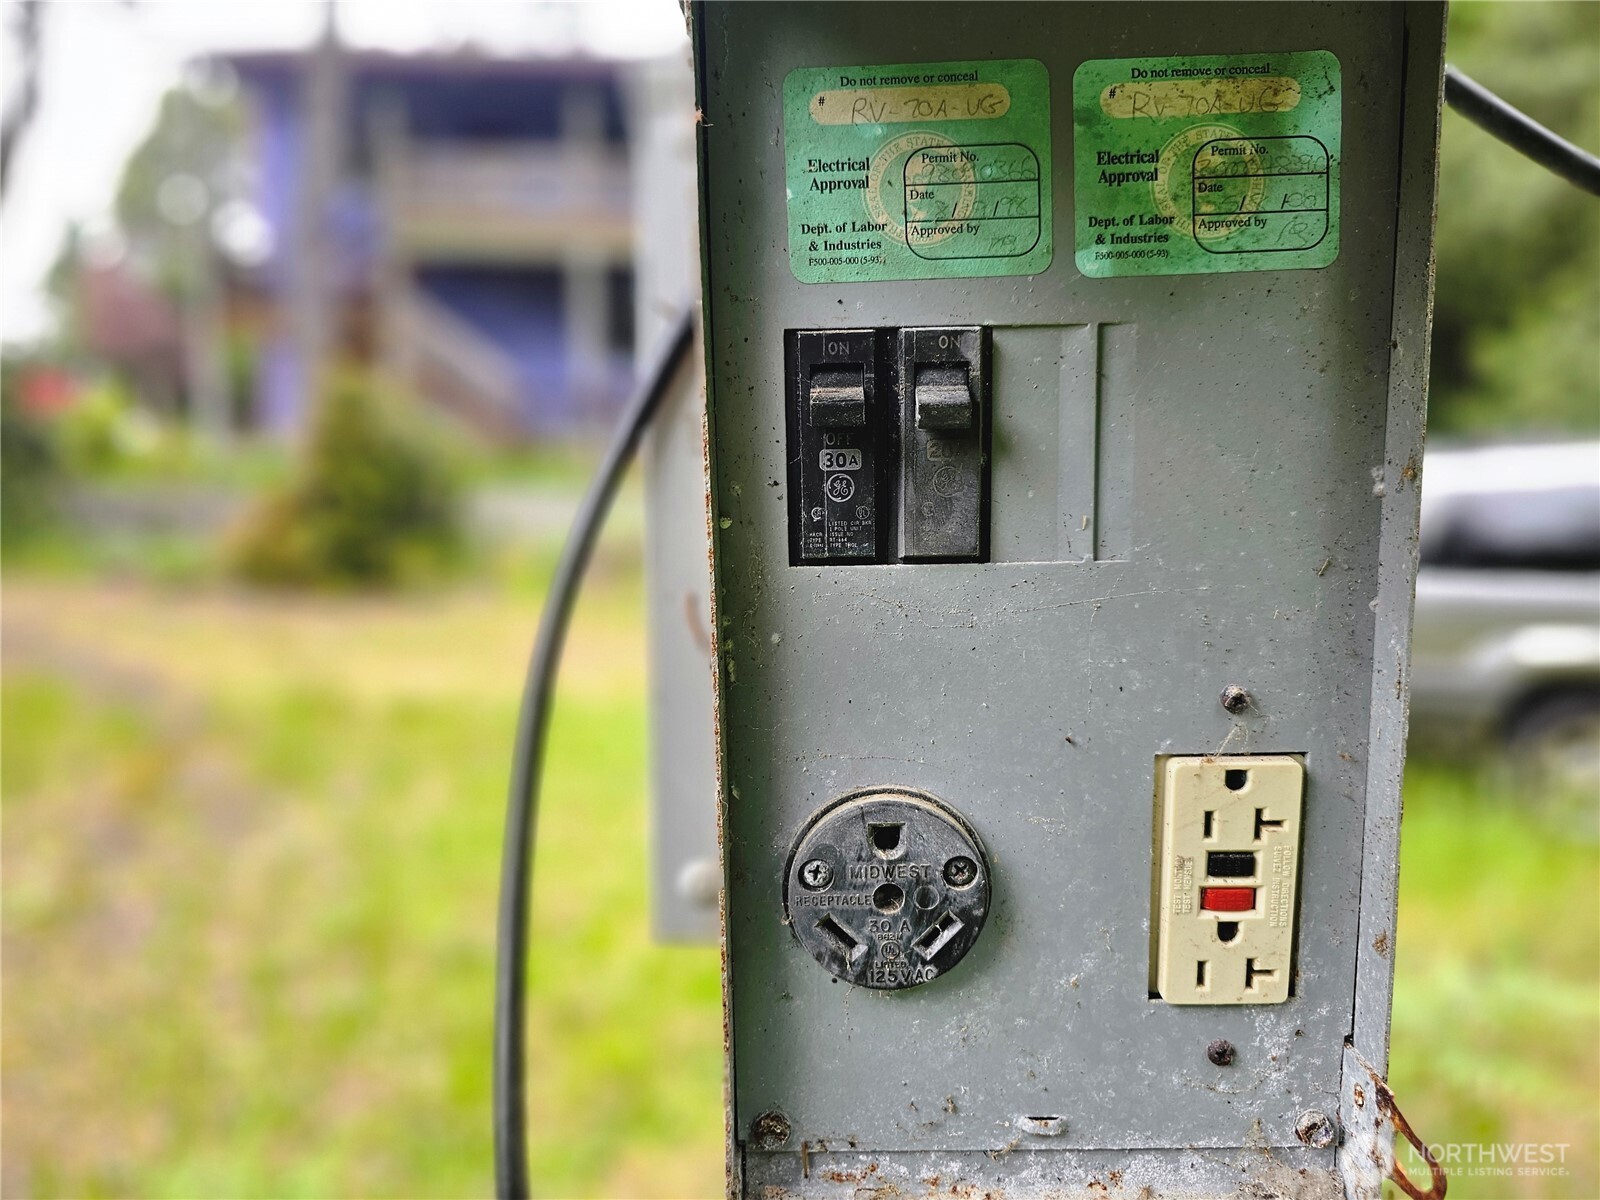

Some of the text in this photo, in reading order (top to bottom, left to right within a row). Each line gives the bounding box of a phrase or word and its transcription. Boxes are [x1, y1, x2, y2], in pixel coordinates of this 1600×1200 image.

[1132, 64, 1270, 78] Do not remove or conceal
[840, 76, 856, 86] Do
[860, 76, 876, 86] not
[880, 75, 920, 85] remove
[938, 71, 978, 82] conceal
[1109, 88, 1116, 98] #
[818, 96, 825, 106] #
[1210, 144, 1268, 156] Permit No.
[922, 152, 980, 164] Permit No.
[1096, 150, 1159, 165] Electrical
[808, 158, 870, 172] Electrical
[1098, 168, 1158, 186] Approval
[810, 176, 870, 194] Approval
[1198, 182, 1223, 193] Date
[910, 190, 934, 200] Date
[1088, 214, 1174, 229] Dept. of Labor
[1198, 216, 1267, 232] Approved by
[801, 222, 887, 236] Dept. of Labor
[911, 224, 980, 237] Approved by
[808, 240, 882, 251] & Industries
[1095, 232, 1168, 245] & Industries
[828, 342, 849, 355] ON
[938, 336, 960, 349] ON
[825, 452, 858, 468] 30A
[850, 864, 931, 879] MIDWEST
[1279, 846, 1292, 926] FOLLOW DIRECTIONS
[796, 895, 872, 906] RECEPTACLE
[1172, 895, 1181, 914] TEST
[1182, 894, 1191, 913] TEST
[869, 920, 912, 932] 30 A
